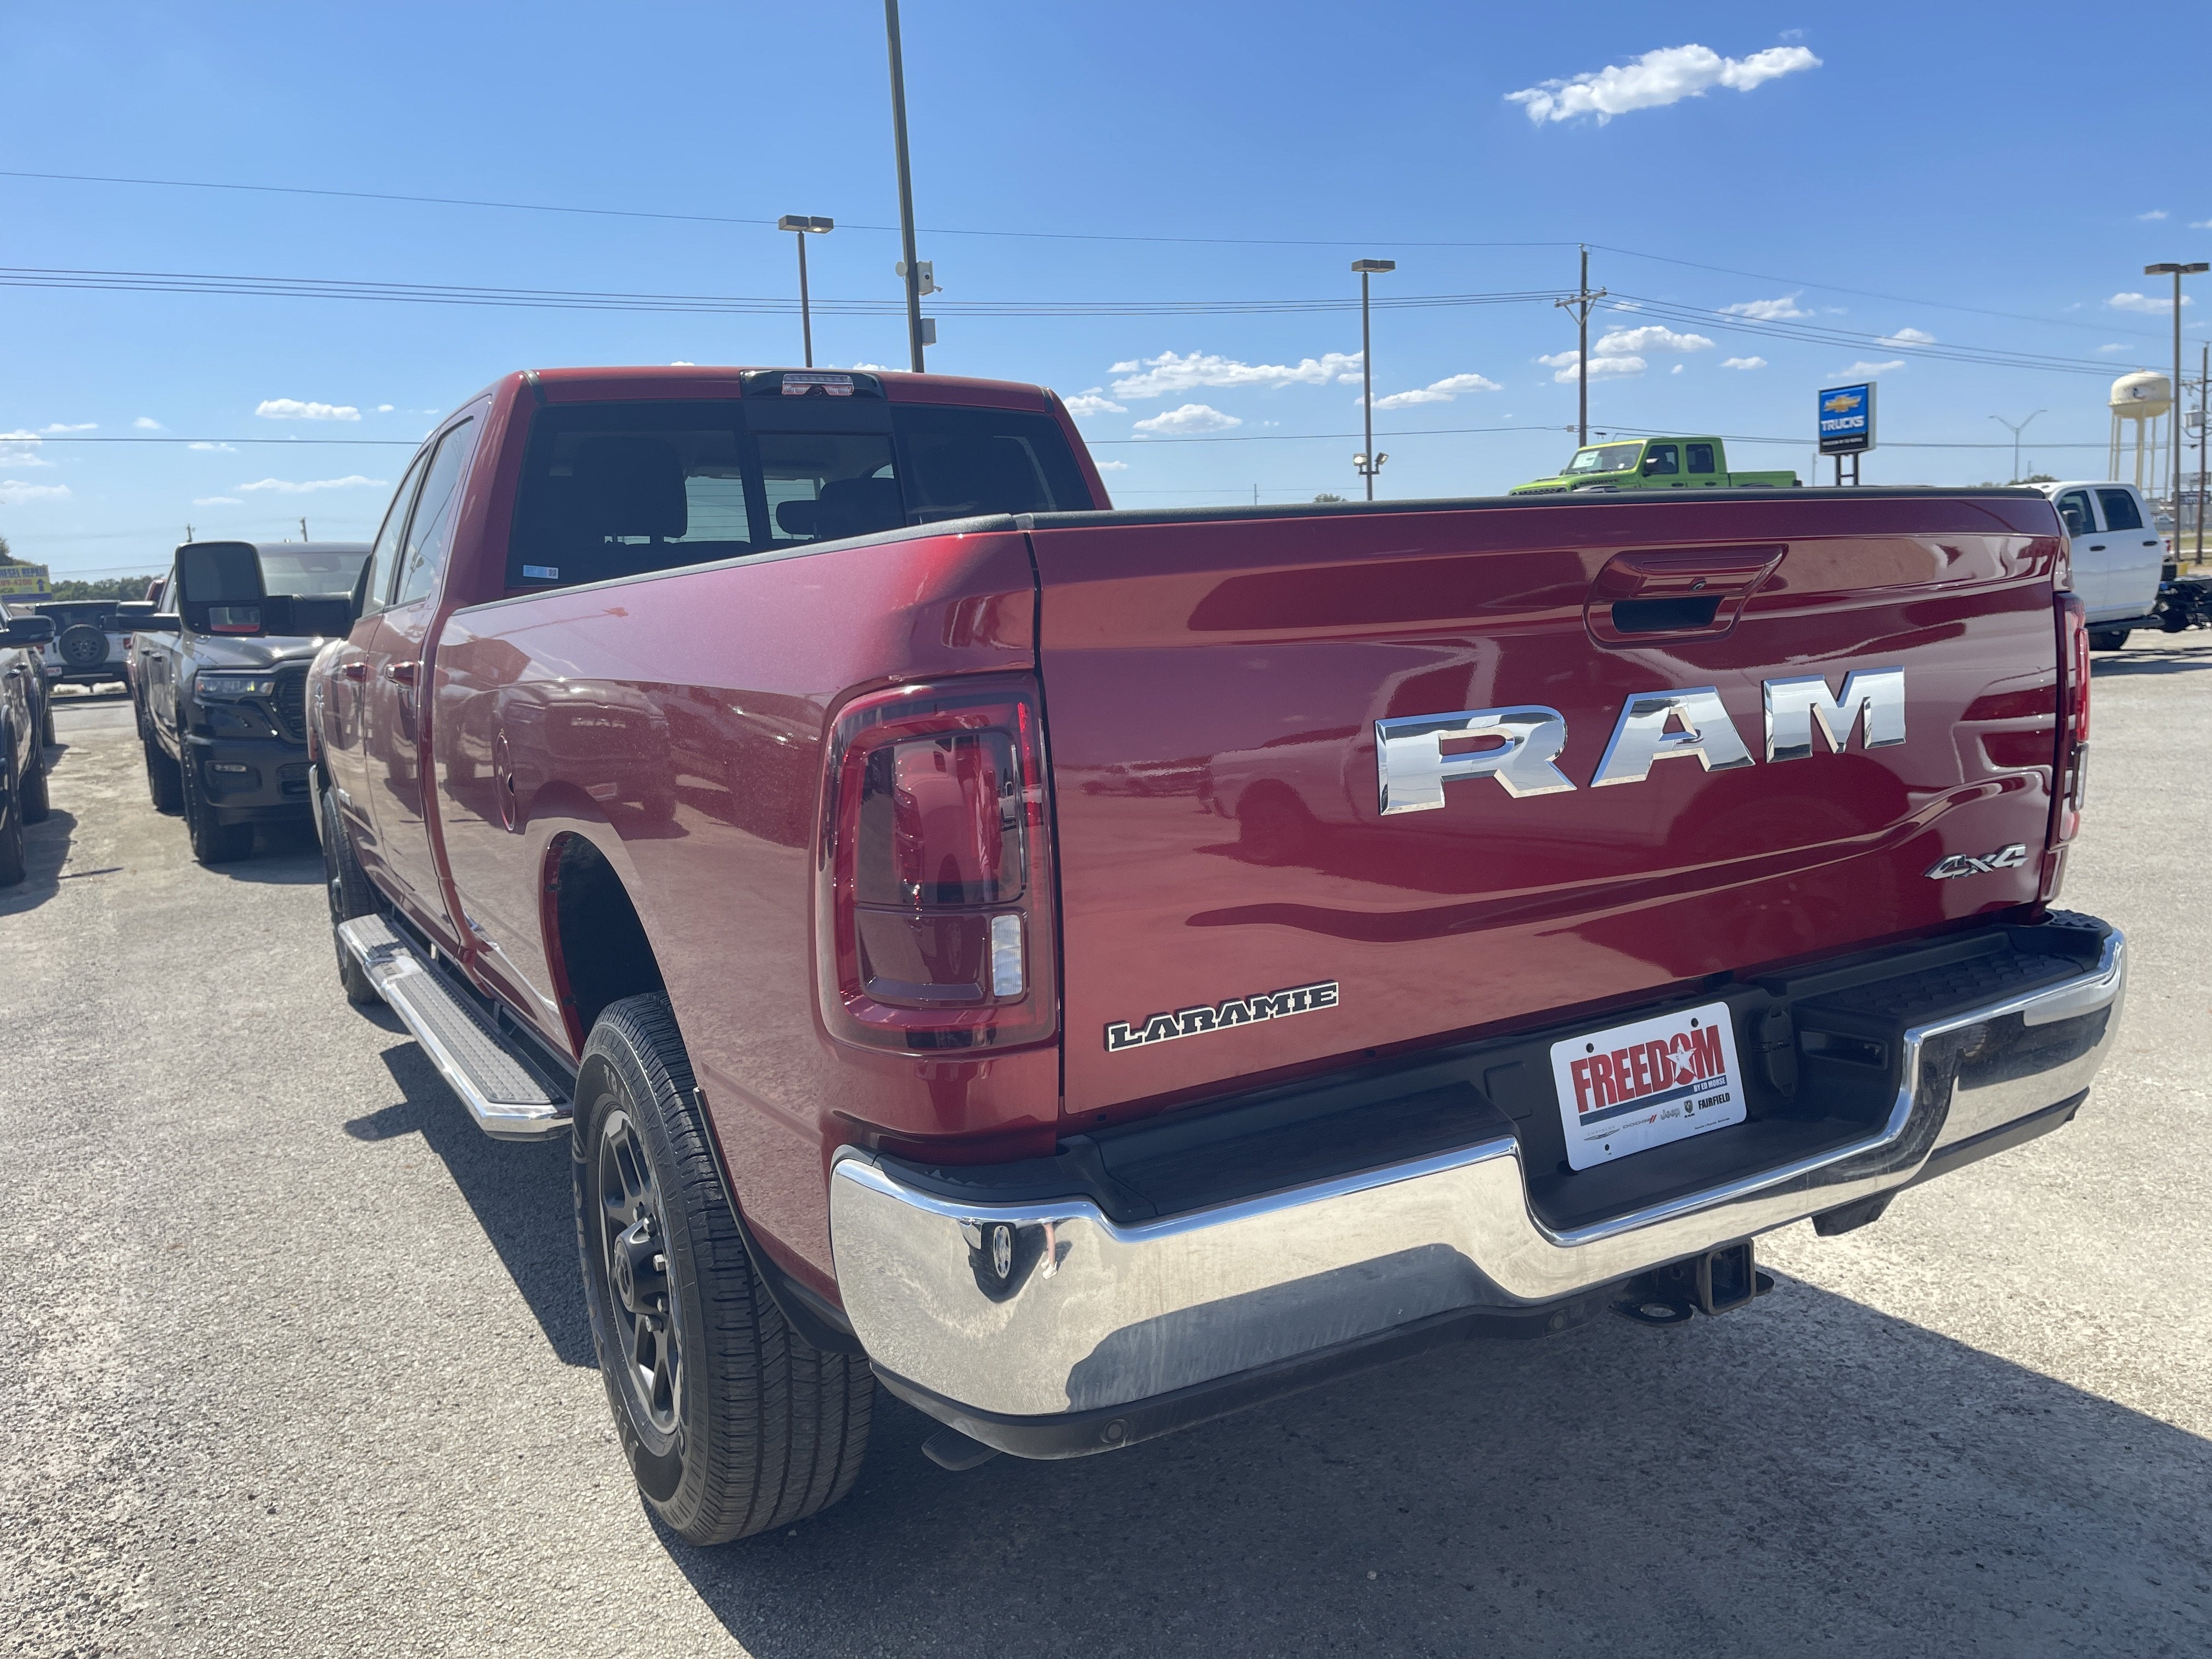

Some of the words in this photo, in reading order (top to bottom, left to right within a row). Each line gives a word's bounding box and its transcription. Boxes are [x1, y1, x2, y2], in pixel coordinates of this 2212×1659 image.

[1820, 415, 1864, 431] TRUCKS
[22, 568, 46, 577] REPAIR
[1375, 665, 1906, 816] RAM
[1105, 980, 1339, 1052] LARAMIE
[1570, 1024, 1725, 1113] FREEDOM
[1693, 1084, 1701, 1092] BY
[1701, 1081, 1708, 1090] ED
[1708, 1077, 1726, 1088] MORSE
[1698, 1092, 1730, 1110] FAIRFIELD
[1660, 1108, 1680, 1120] Jeep
